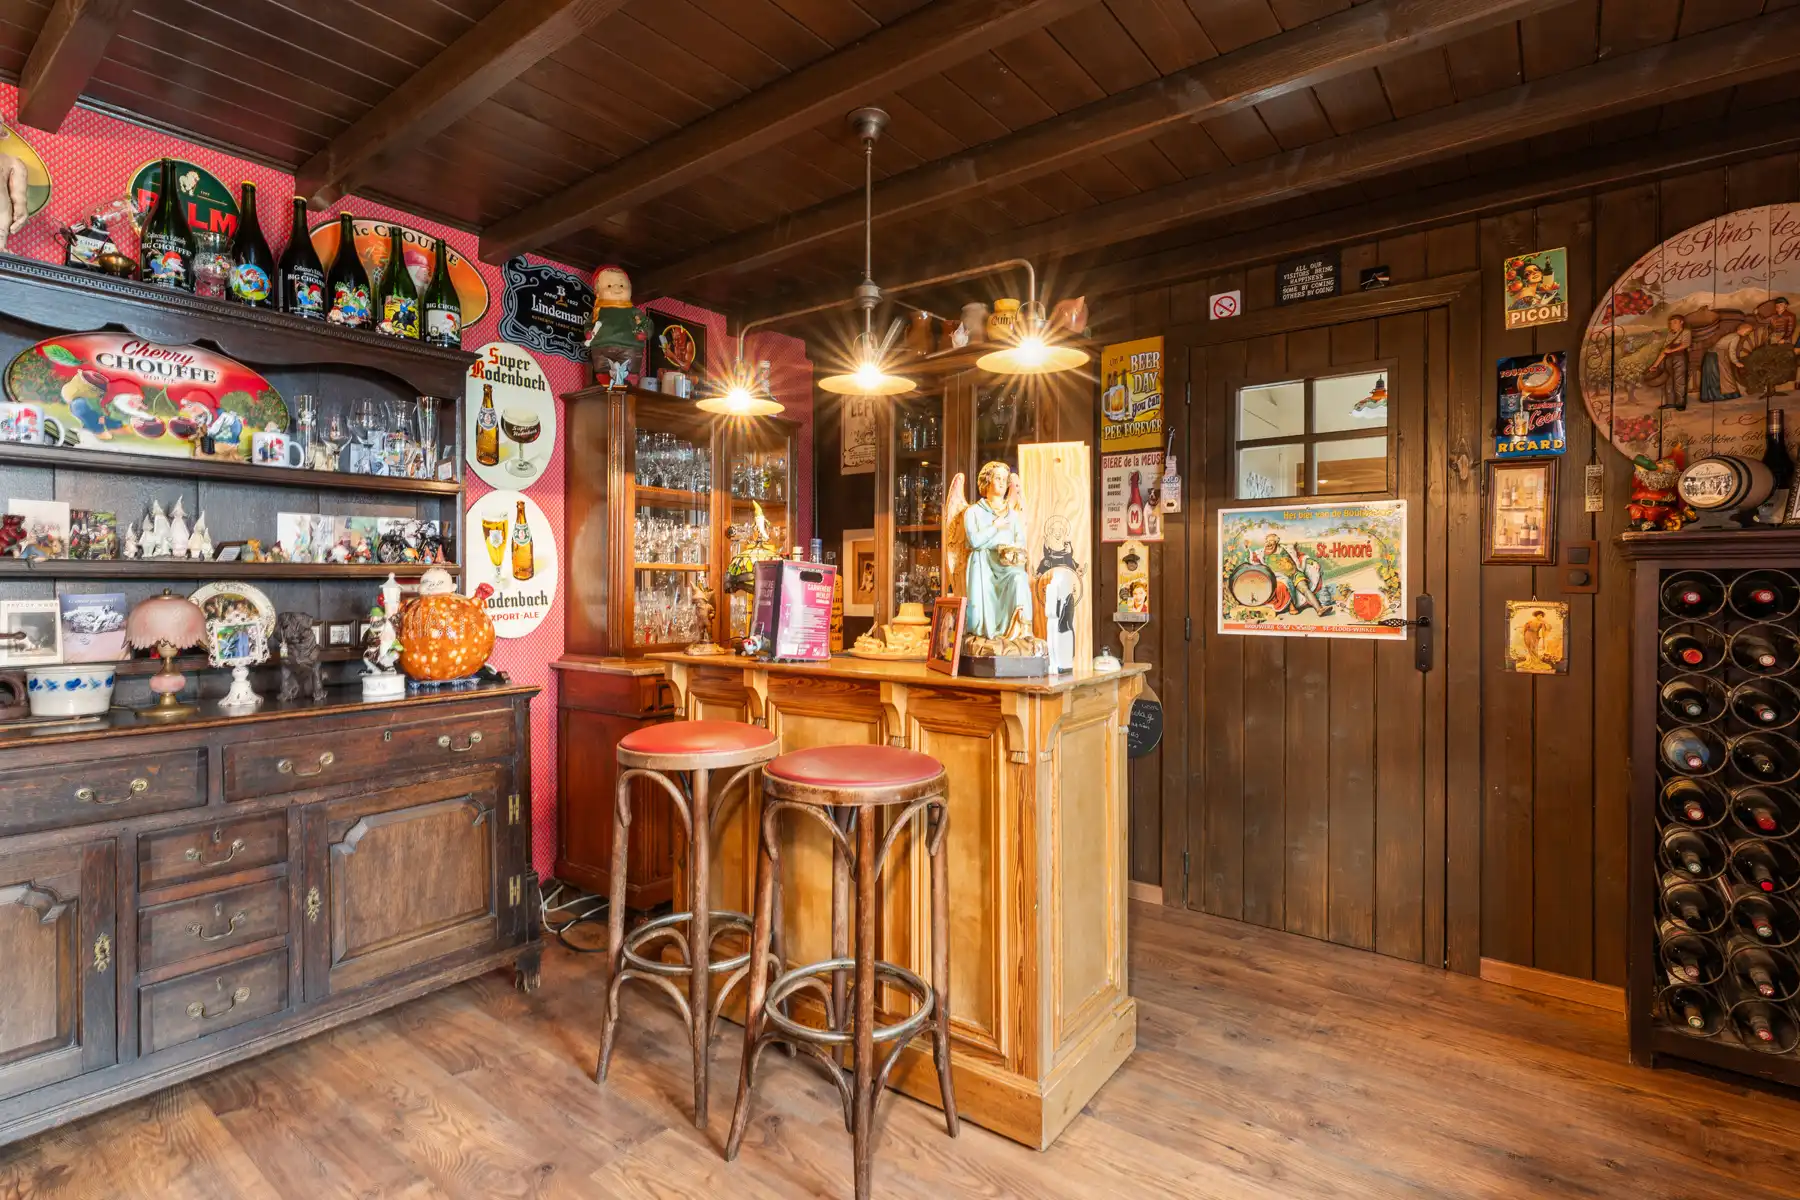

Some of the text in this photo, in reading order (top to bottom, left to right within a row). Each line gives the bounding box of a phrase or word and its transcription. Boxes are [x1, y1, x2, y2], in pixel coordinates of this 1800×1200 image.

[137, 187, 239, 238] PLM
[374, 224, 459, 266] COUFE
[1295, 261, 1323, 272] ALL OUR
[1723, 245, 1766, 273] du
[1283, 265, 1333, 280] VISITORS BRING
[1290, 273, 1324, 285] HAPPINESS
[1310, 280, 1334, 289] COMING
[1282, 291, 1306, 300] OTHERS
[1511, 305, 1562, 325] PICON
[121, 340, 195, 368] Cherry
[487, 347, 531, 371] Super
[1130, 351, 1161, 373] BEER
[96, 353, 217, 383] CHOUFFE
[469, 360, 546, 392] Rodenbach
[1500, 365, 1548, 378] TOUJOURS
[1133, 371, 1159, 394] DAY
[1132, 394, 1160, 417] you can
[1104, 418, 1163, 440] PEE FOREVER
[1498, 439, 1565, 453] RICARD
[1103, 451, 1165, 469] BIERE de la MEUSE
[1331, 509, 1342, 518] de
[491, 610, 540, 622] XPORT-ALE
